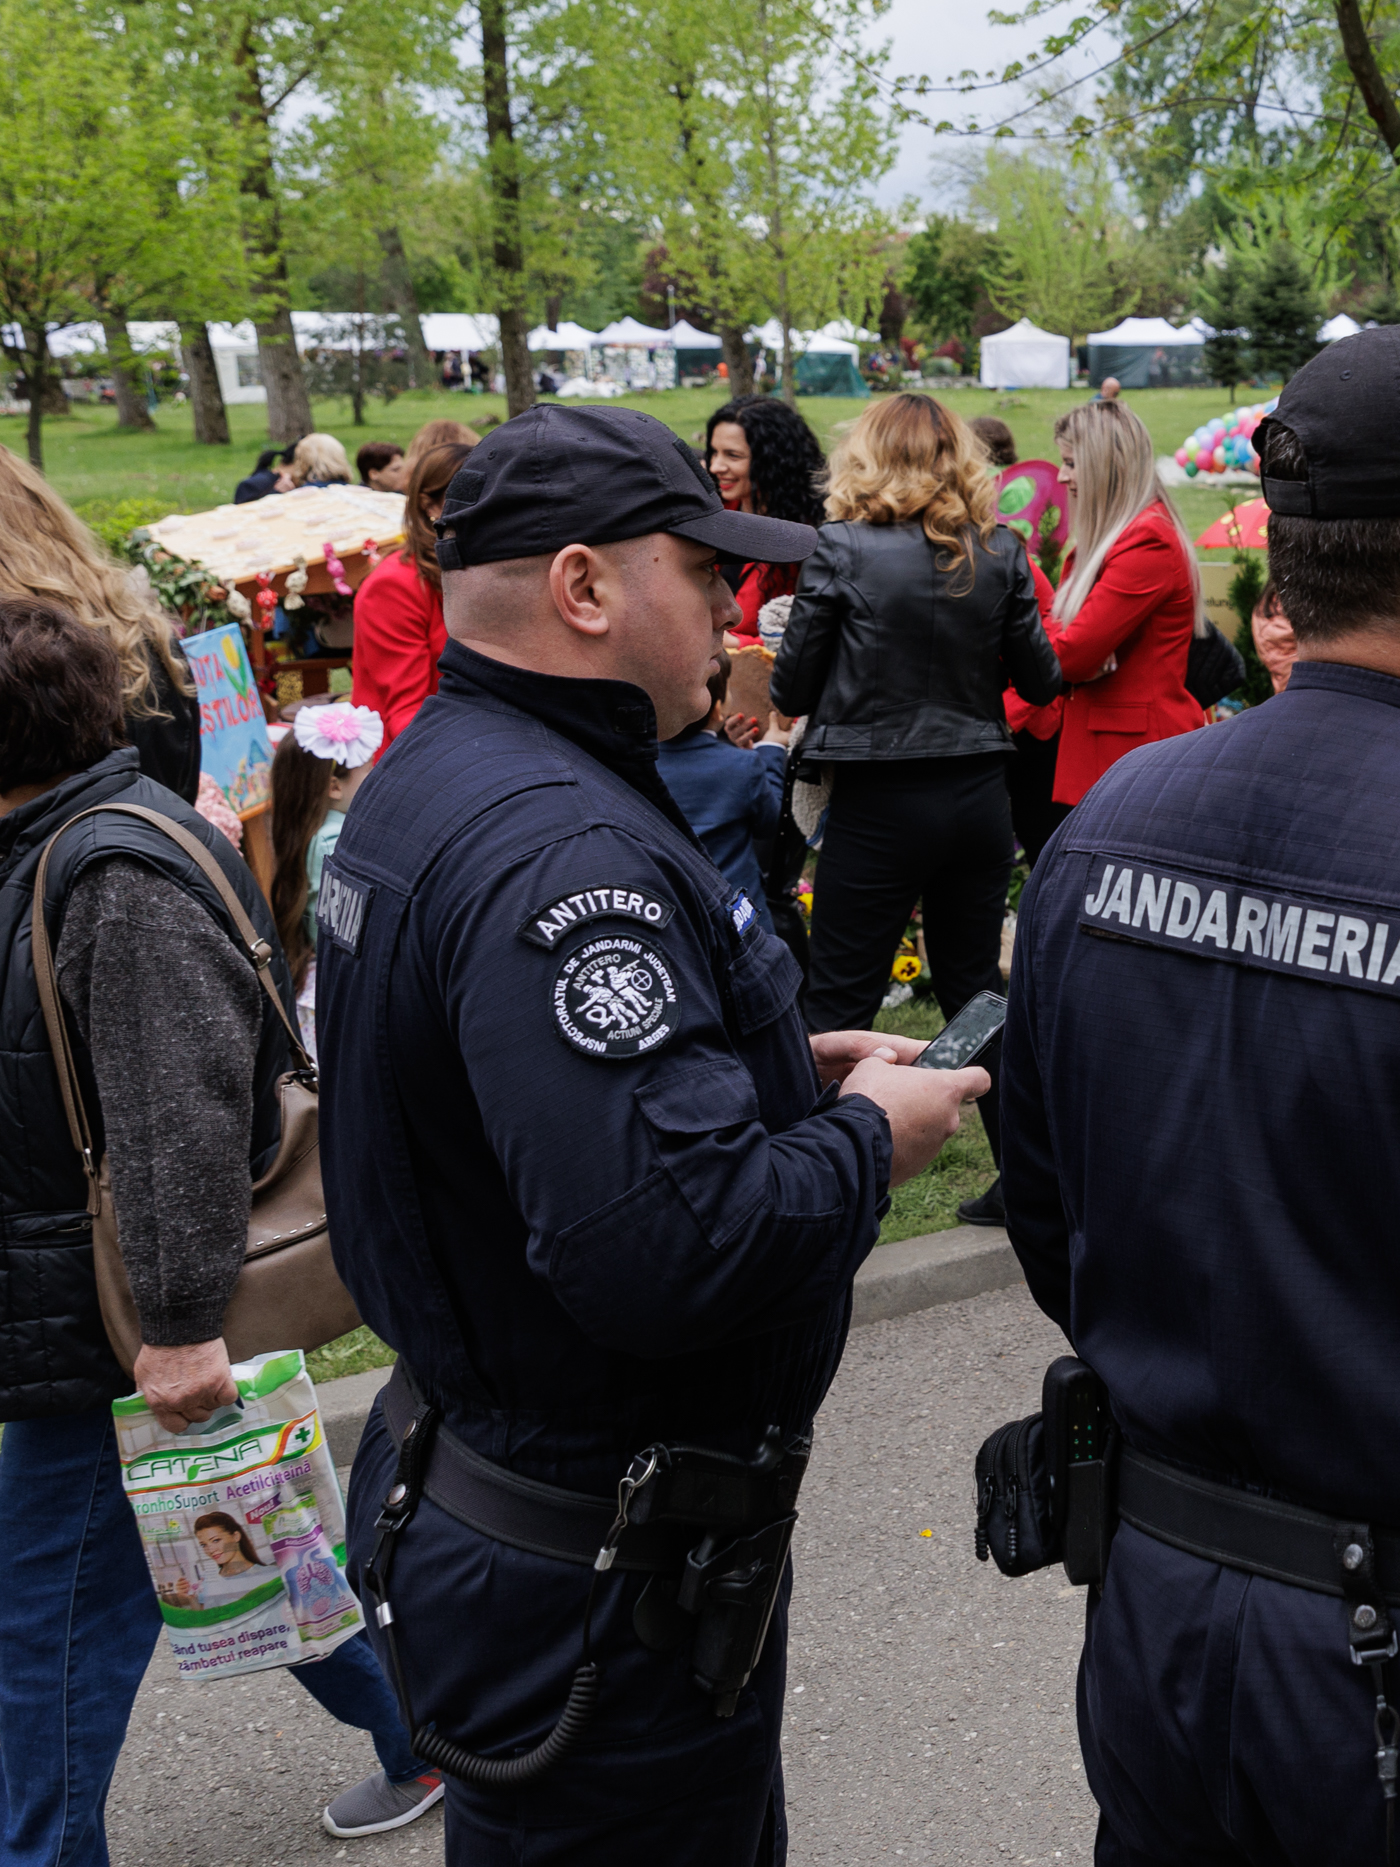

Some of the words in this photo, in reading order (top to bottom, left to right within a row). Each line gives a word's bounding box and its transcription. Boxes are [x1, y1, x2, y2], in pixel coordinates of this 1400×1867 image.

[199, 687, 264, 742] ȘTILOR
[536, 889, 662, 941] ANTITERO
[564, 957, 581, 975] DE
[581, 939, 642, 959] JANDARMI
[572, 953, 621, 990] ANTITERO
[554, 977, 607, 1053] INSPECTORATUL
[607, 1025, 643, 1041] ACTIUNI
[641, 997, 664, 1030] SPECIALE
[127, 1439, 263, 1482] CATENA
[226, 1460, 312, 1501] Acetilcisteină
[250, 1499, 275, 1520] Nou!
[178, 1650, 236, 1671] zâmbetul
[238, 1640, 289, 1660] reapare
[197, 1637, 236, 1653] tusea
[237, 1624, 291, 1644] dispare,
